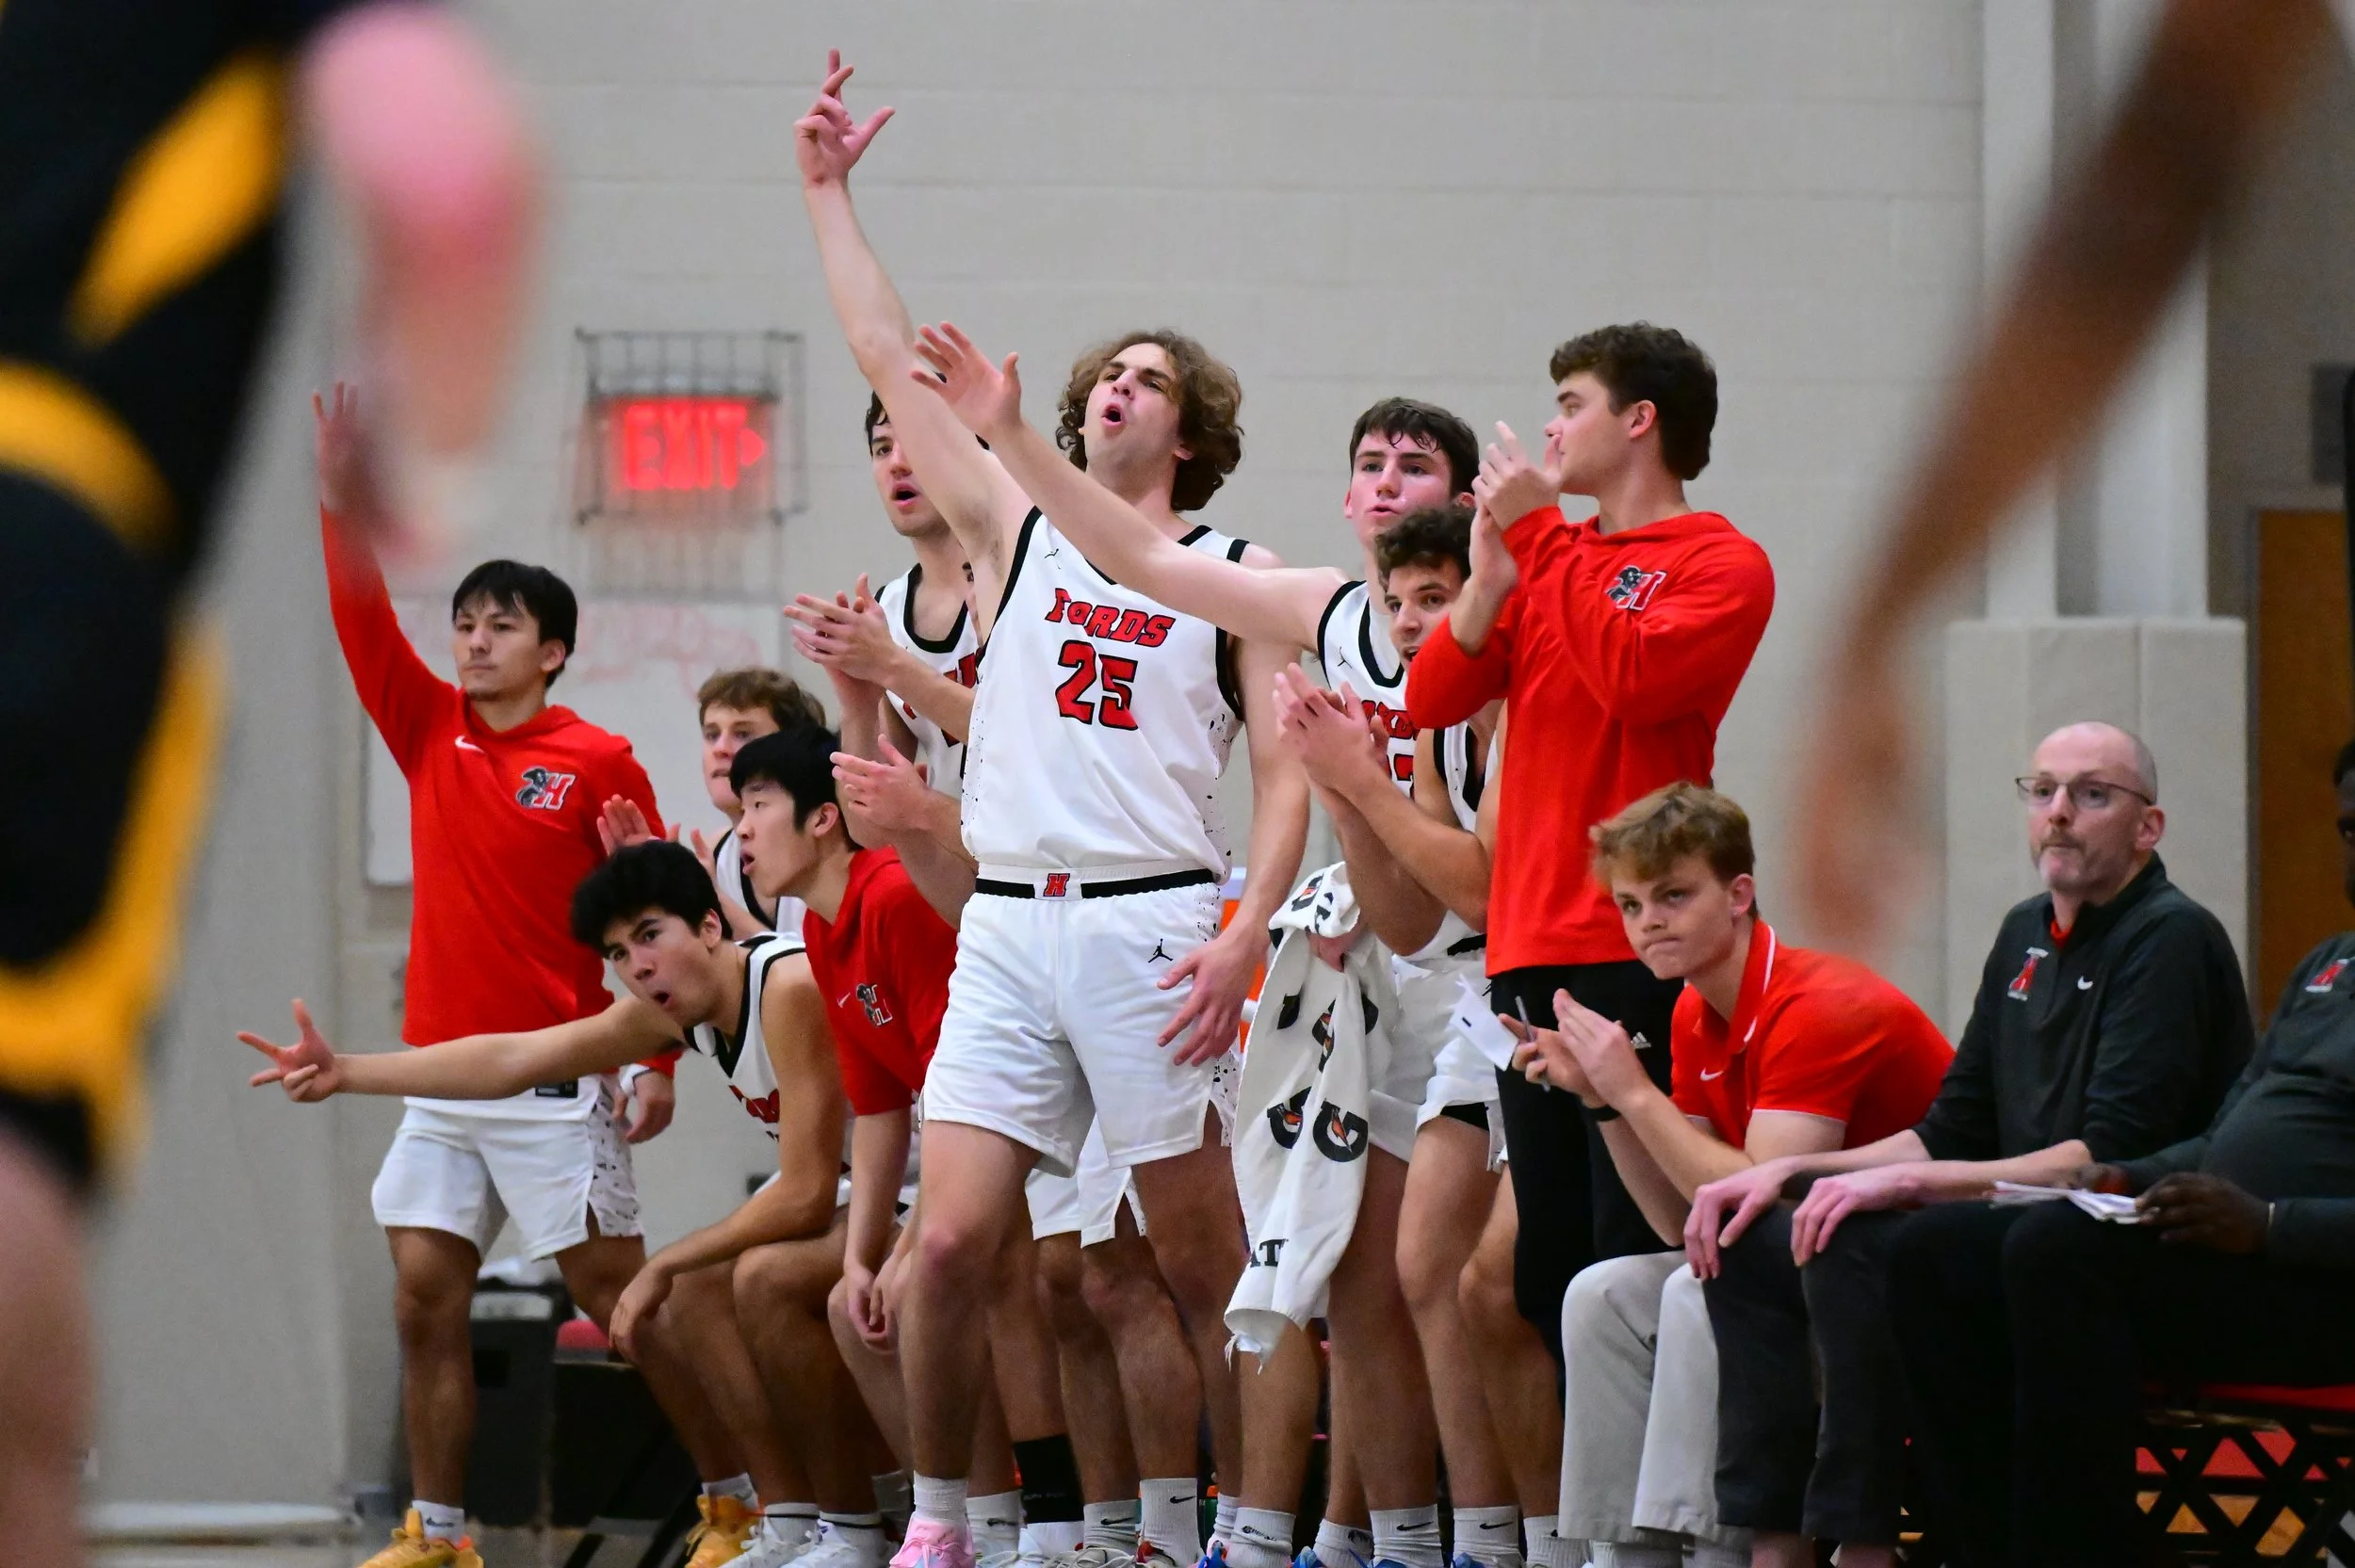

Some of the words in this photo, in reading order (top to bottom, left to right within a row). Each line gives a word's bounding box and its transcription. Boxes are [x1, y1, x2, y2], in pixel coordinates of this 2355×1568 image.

[624, 402, 747, 491] EXIT
[1045, 588, 1177, 648] FORDS
[1055, 639, 1139, 731] 25
[1043, 873, 1071, 897] H
